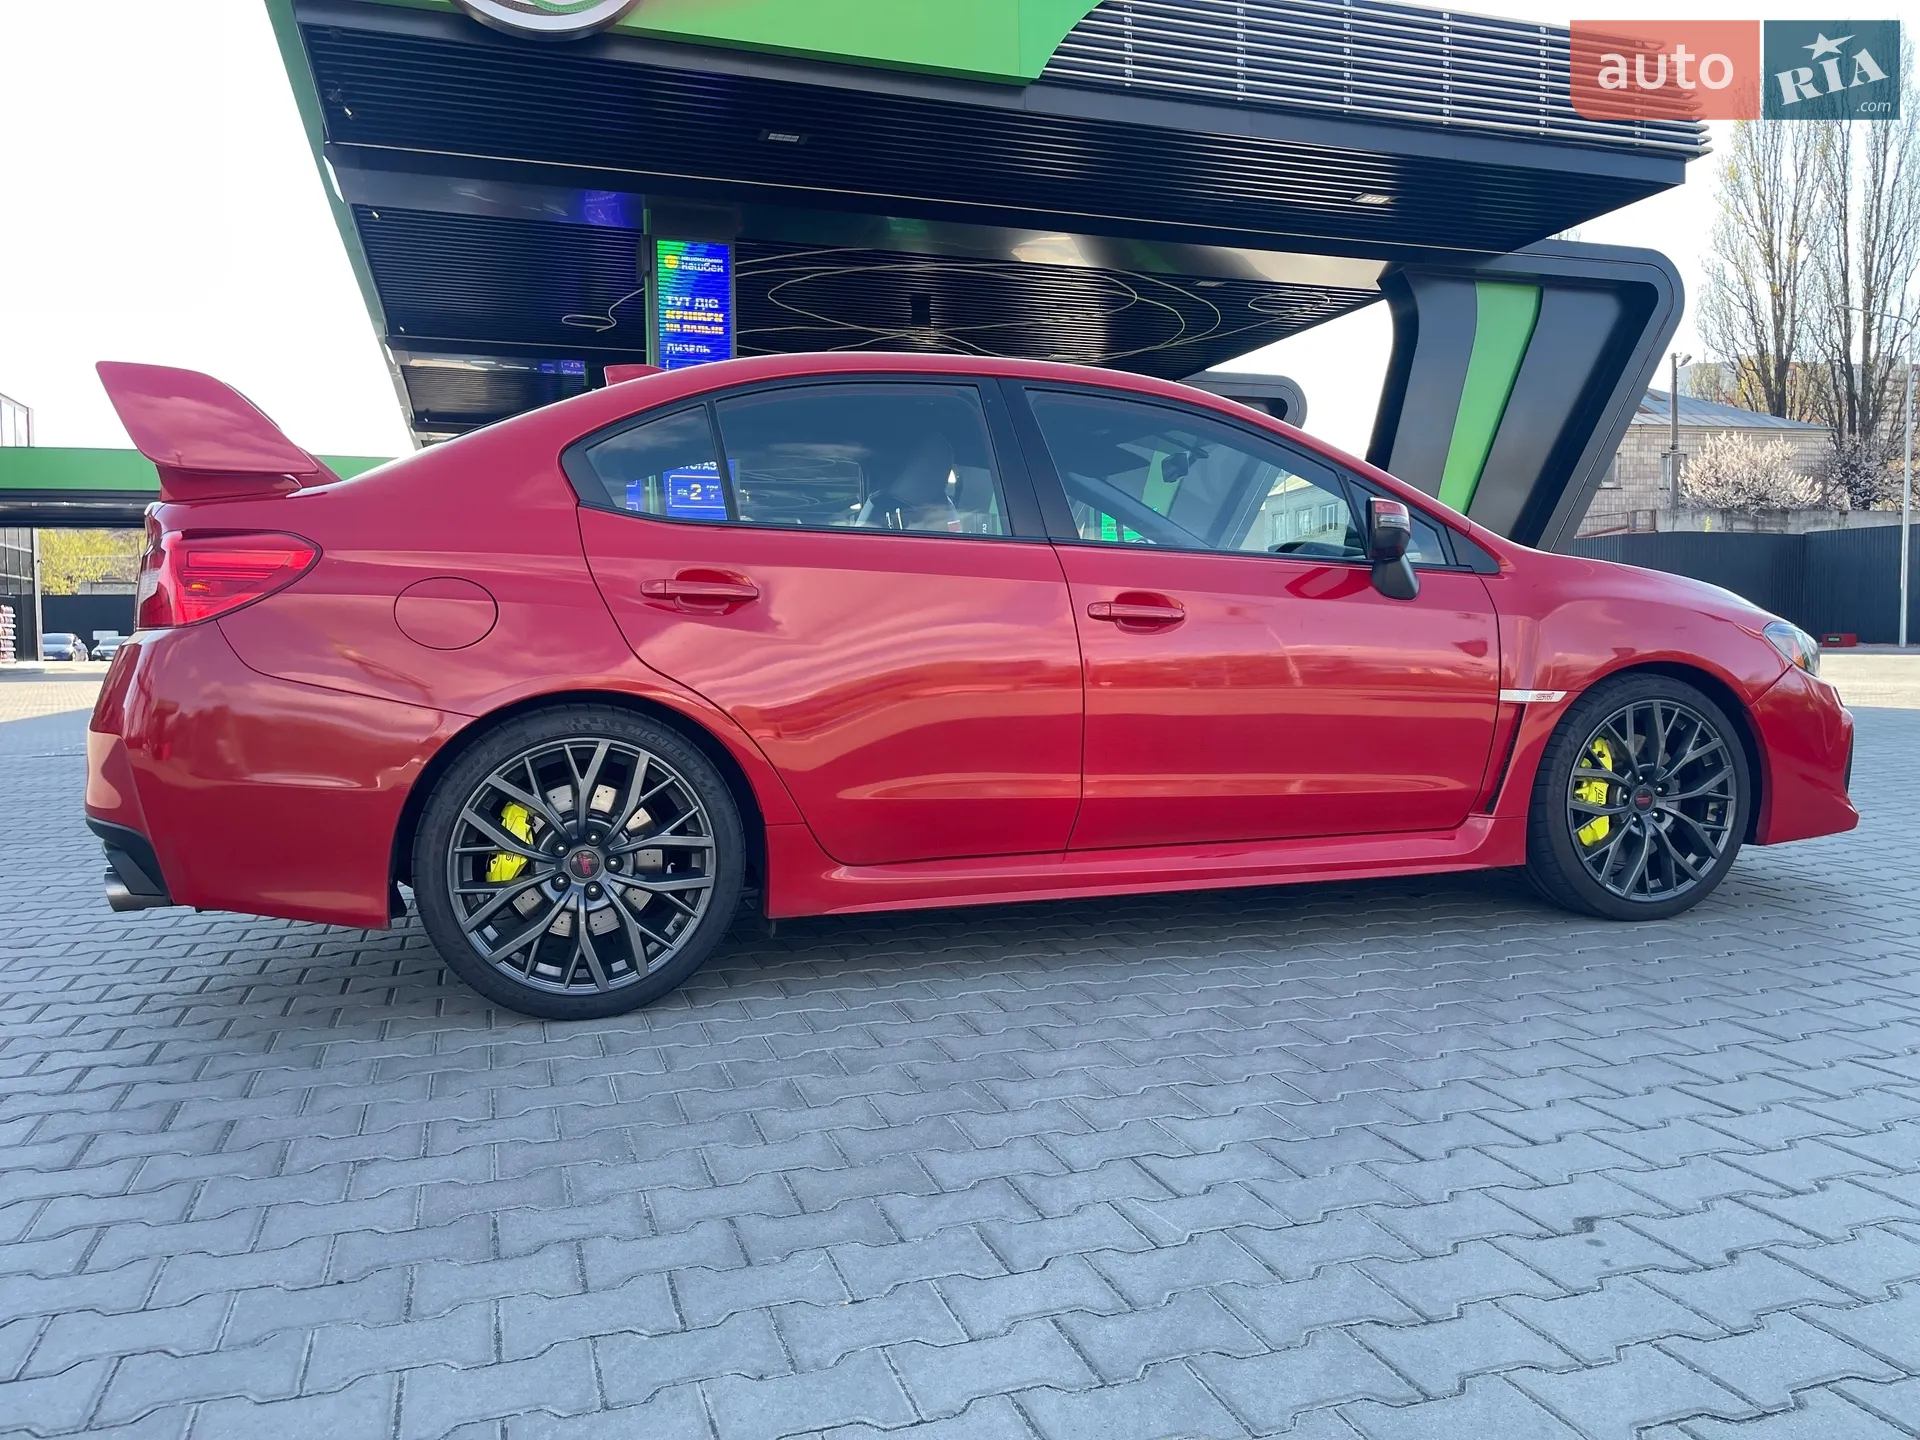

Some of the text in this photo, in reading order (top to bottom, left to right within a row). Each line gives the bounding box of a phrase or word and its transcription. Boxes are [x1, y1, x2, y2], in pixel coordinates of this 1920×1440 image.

[665, 296, 692, 307] ТУТ
[665, 310, 724, 323] КЕШБЕК
[665, 323, 681, 332] НА
[666, 343, 710, 353] ДИЗЕЛЬ
[690, 484, 702, 500] 2
[627, 726, 697, 769] MICHELIN
